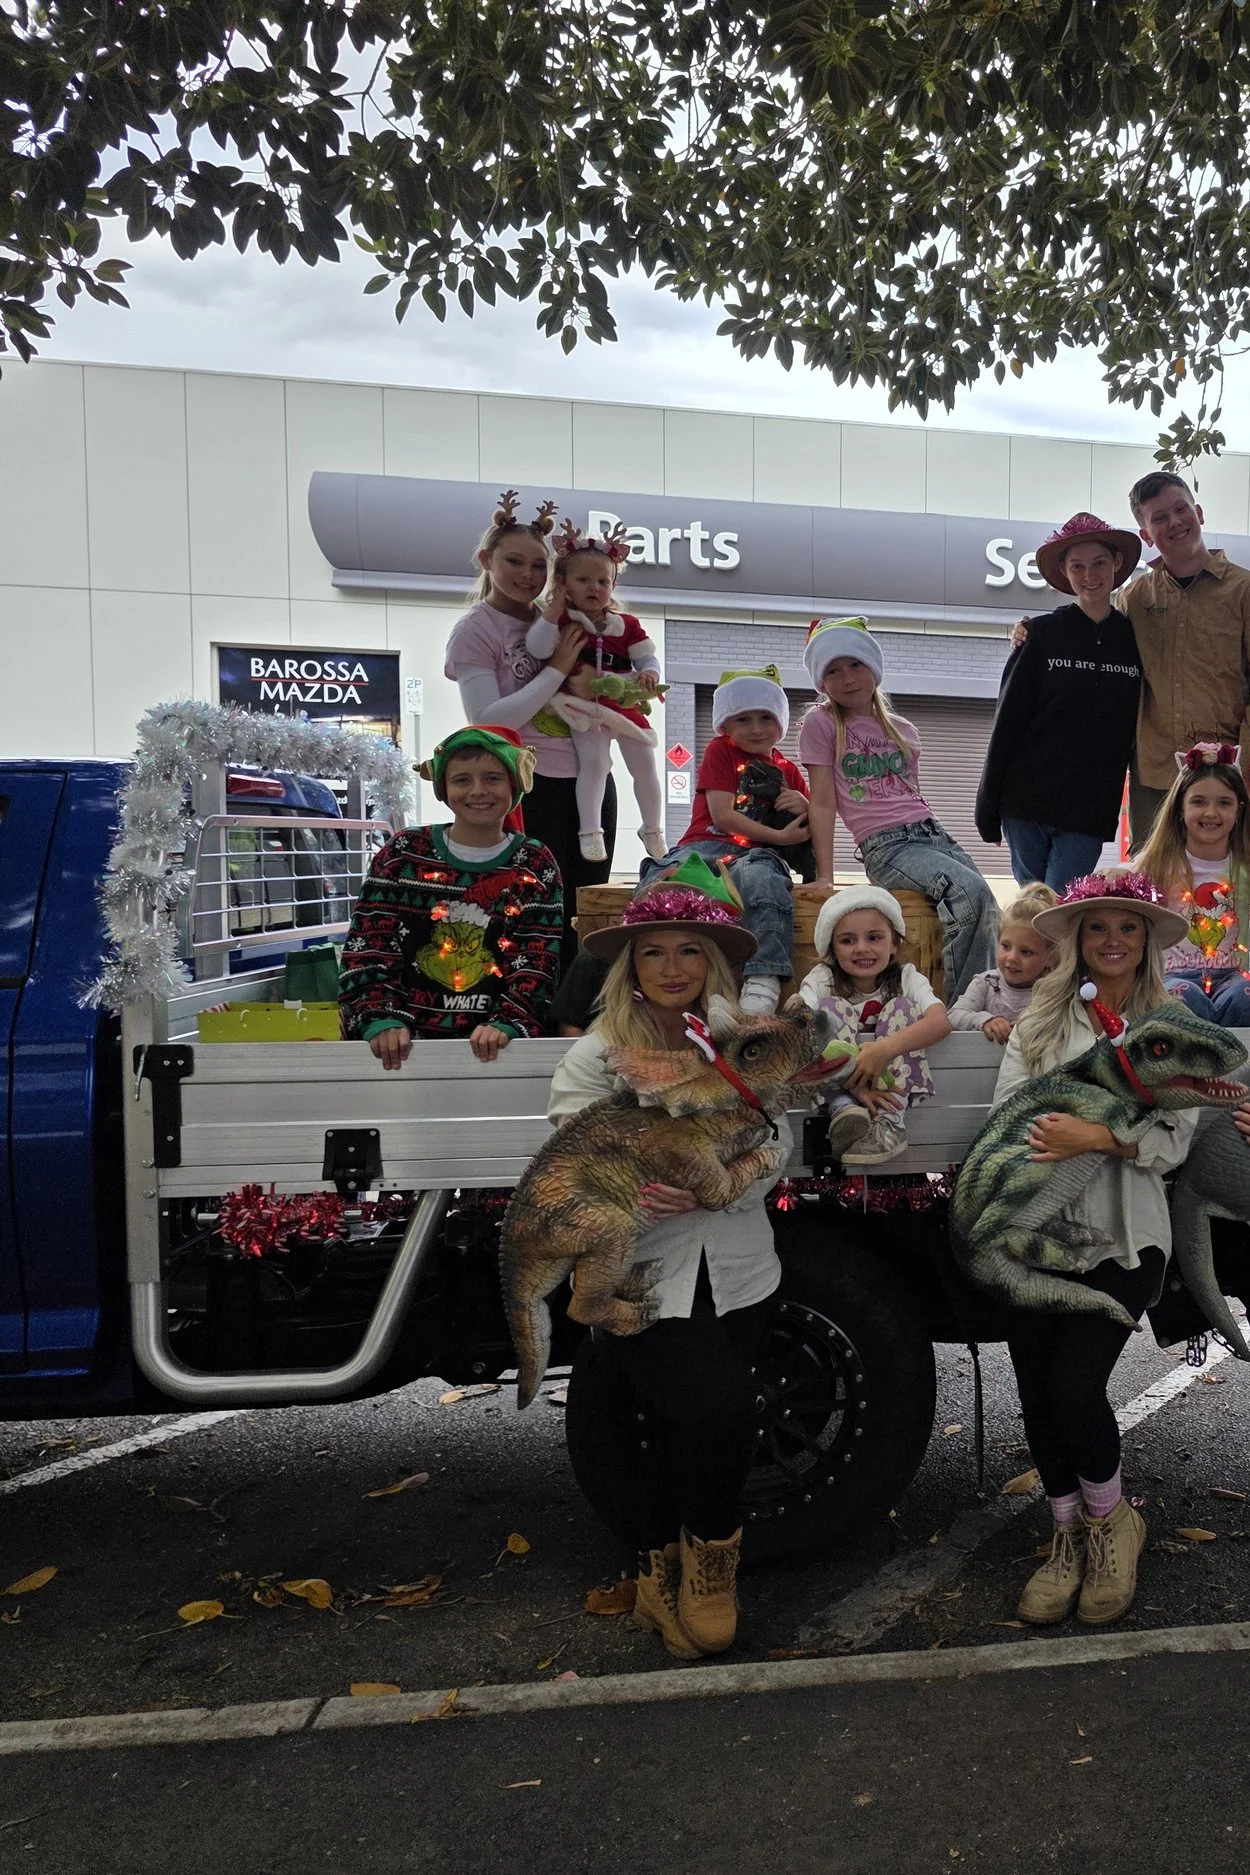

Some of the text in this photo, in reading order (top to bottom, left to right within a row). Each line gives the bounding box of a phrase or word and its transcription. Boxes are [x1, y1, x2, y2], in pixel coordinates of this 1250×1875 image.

[587, 510, 741, 570] Parts
[250, 657, 369, 682] BAROSSA
[1047, 658, 1072, 671] you
[1075, 660, 1096, 670] are
[259, 681, 362, 704] MAZDA
[406, 679, 422, 689] 2P
[842, 752, 909, 778] GRINC
